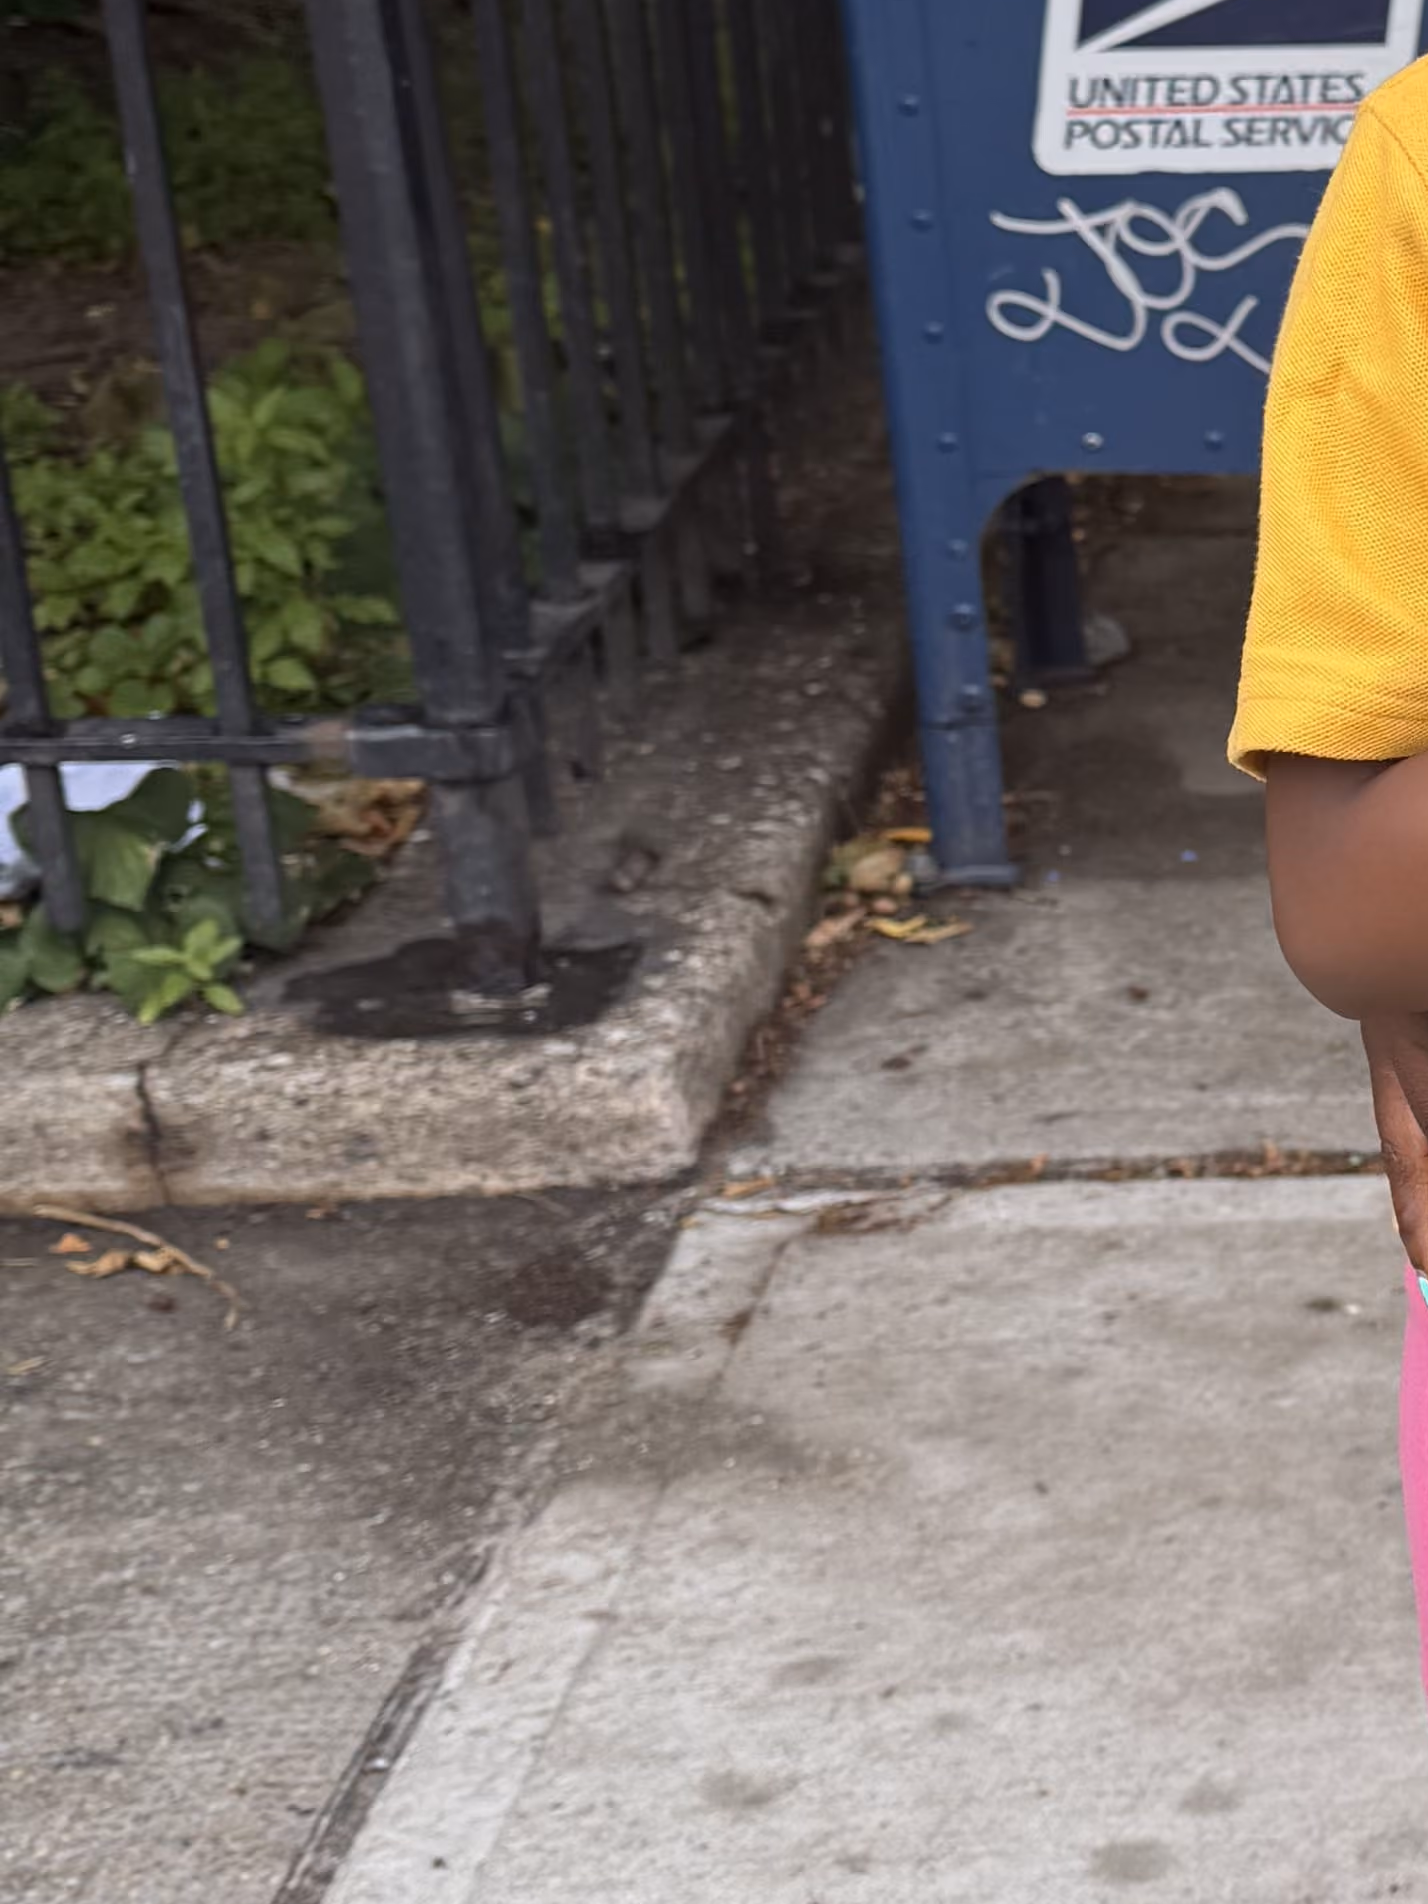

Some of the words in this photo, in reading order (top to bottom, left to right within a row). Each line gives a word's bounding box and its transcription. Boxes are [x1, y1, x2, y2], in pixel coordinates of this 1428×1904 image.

[1068, 75, 1221, 108] UNITED
[1228, 72, 1365, 105] STATES
[1063, 118, 1216, 150] POSTAL
[1222, 112, 1358, 147] SERVIC
